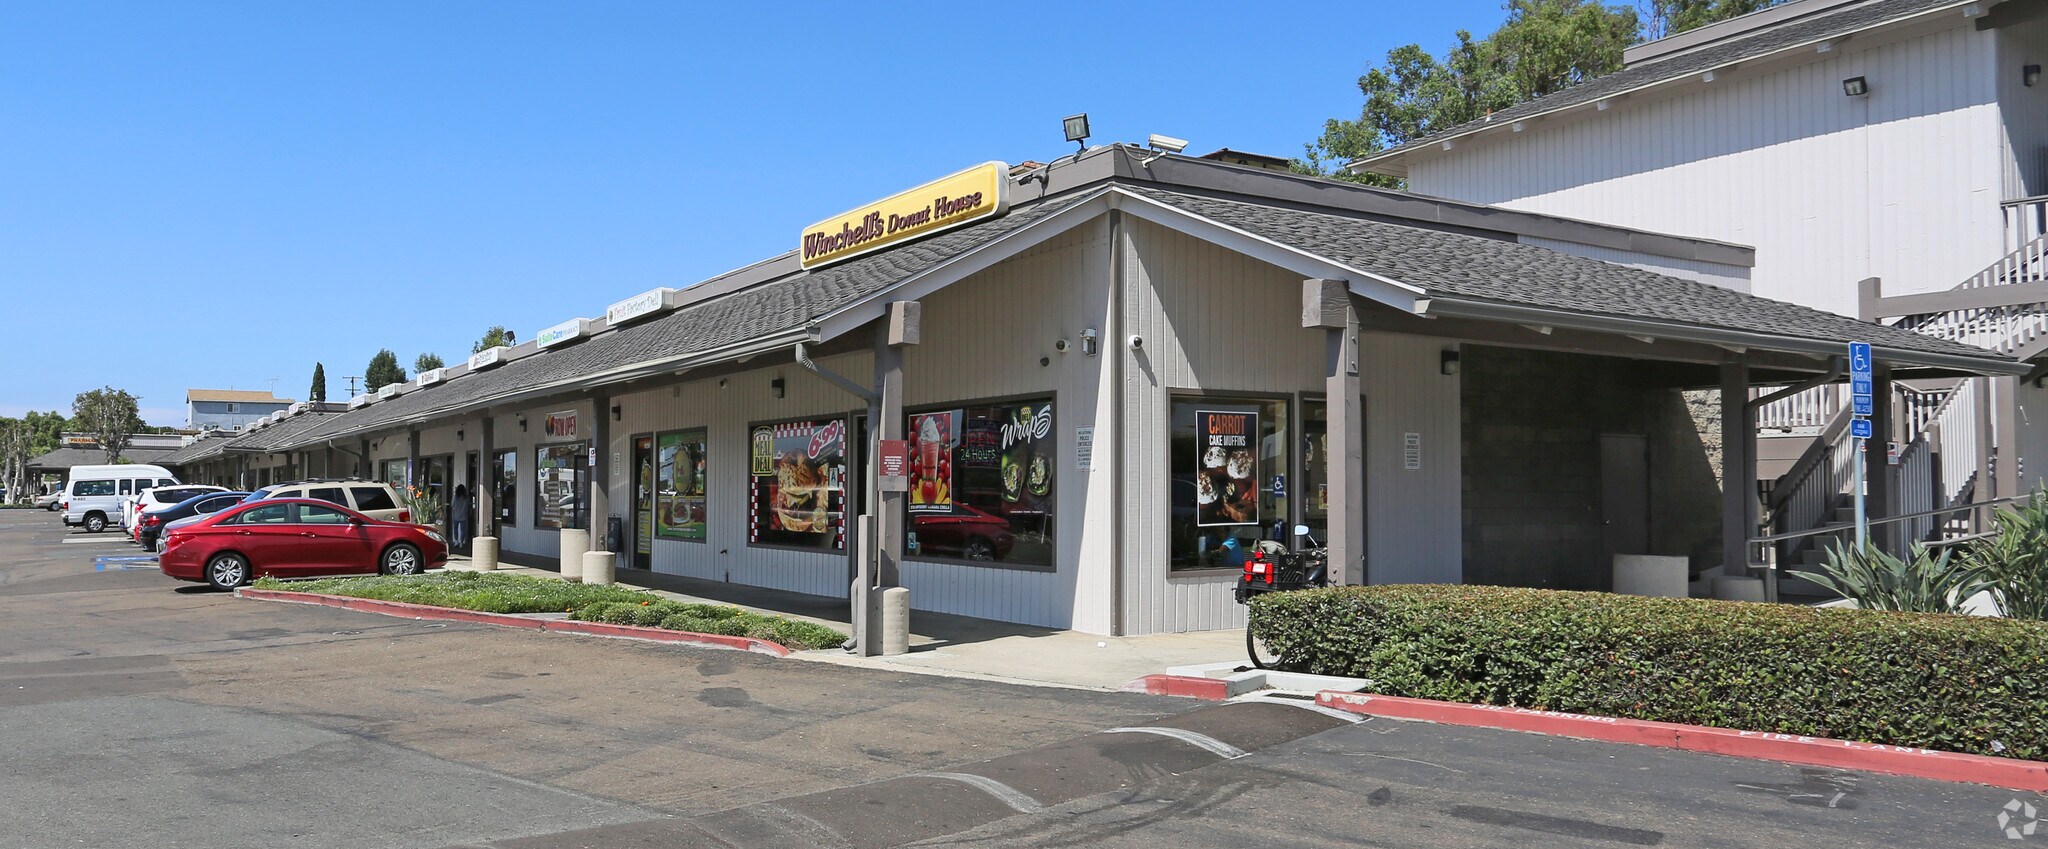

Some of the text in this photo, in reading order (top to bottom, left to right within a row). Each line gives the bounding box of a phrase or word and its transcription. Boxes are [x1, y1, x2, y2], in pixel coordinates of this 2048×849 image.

[804, 191, 983, 260] Winchell's Donut House
[626, 300, 647, 316] Factory
[647, 293, 660, 307] Deli
[1852, 371, 1871, 382] PARKING
[1855, 382, 1867, 393] ONLY
[565, 415, 577, 436] OPEN
[1208, 415, 1246, 435] CARROT
[961, 432, 996, 448] OPEN
[1209, 435, 1246, 446] CAKE MUFFINS
[755, 441, 771, 456] MEAL
[960, 449, 970, 460] 24
[755, 457, 771, 472] DEAL
[1515, 708, 1617, 723] PARKING
[1739, 730, 1939, 755] FIRE LANE
